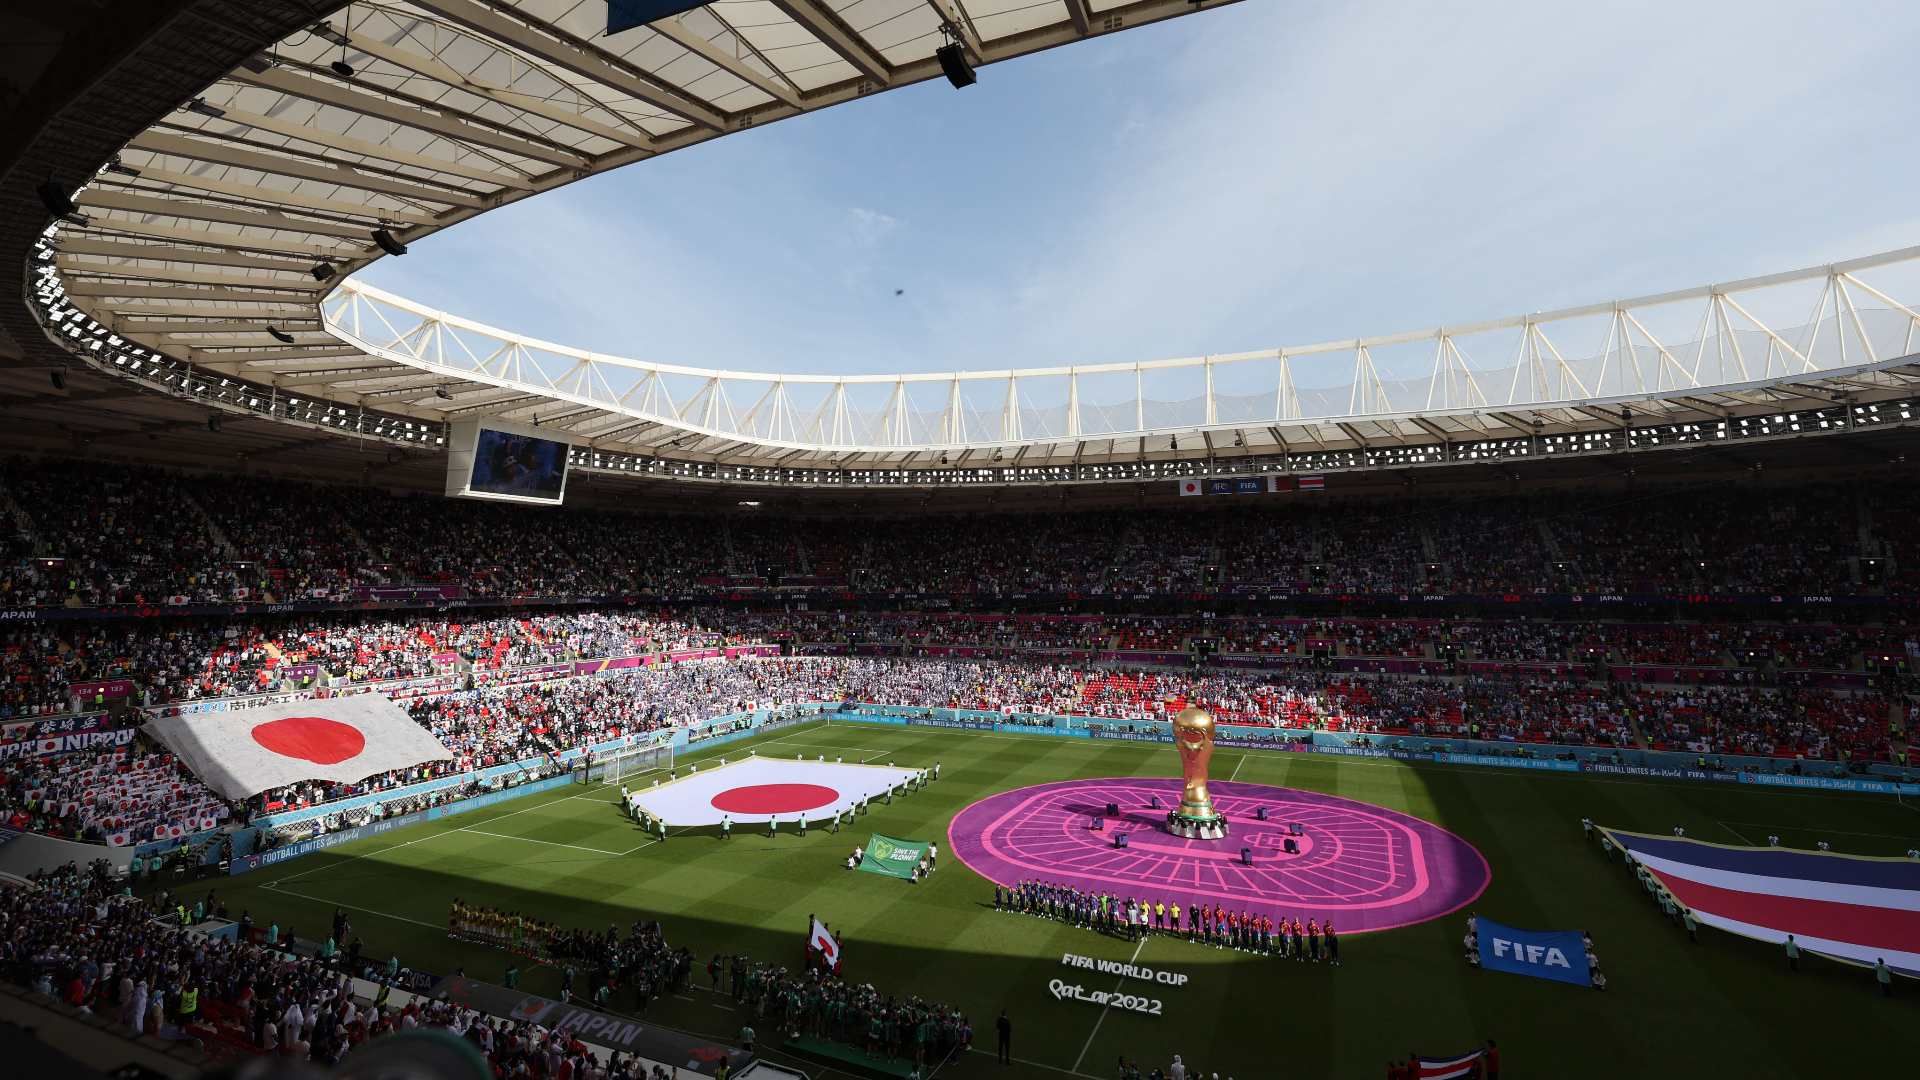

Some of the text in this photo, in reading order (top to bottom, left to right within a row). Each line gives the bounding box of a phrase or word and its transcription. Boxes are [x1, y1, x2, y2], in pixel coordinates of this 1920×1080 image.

[267, 605, 294, 613] JAPAN
[1320, 746, 1344, 754] FOOTBALL
[1450, 754, 1477, 764] FOOTBALL
[1478, 756, 1498, 766] UNITES
[1595, 765, 1682, 778] FOOTBALL UNITES the World
[1758, 775, 1792, 785] FOOTBALL
[1794, 777, 1818, 787] UNITES
[1863, 783, 1884, 791] FIFA
[374, 822, 392, 833] FIFA
[262, 830, 360, 865] FOOTBALL UNITES the World
[1493, 938, 1571, 968] FIFA
[1062, 953, 1188, 986] FIFA WORLD CUP
[1049, 979, 1163, 1016] Qatar2022
[559, 1009, 643, 1046] JAPAN
